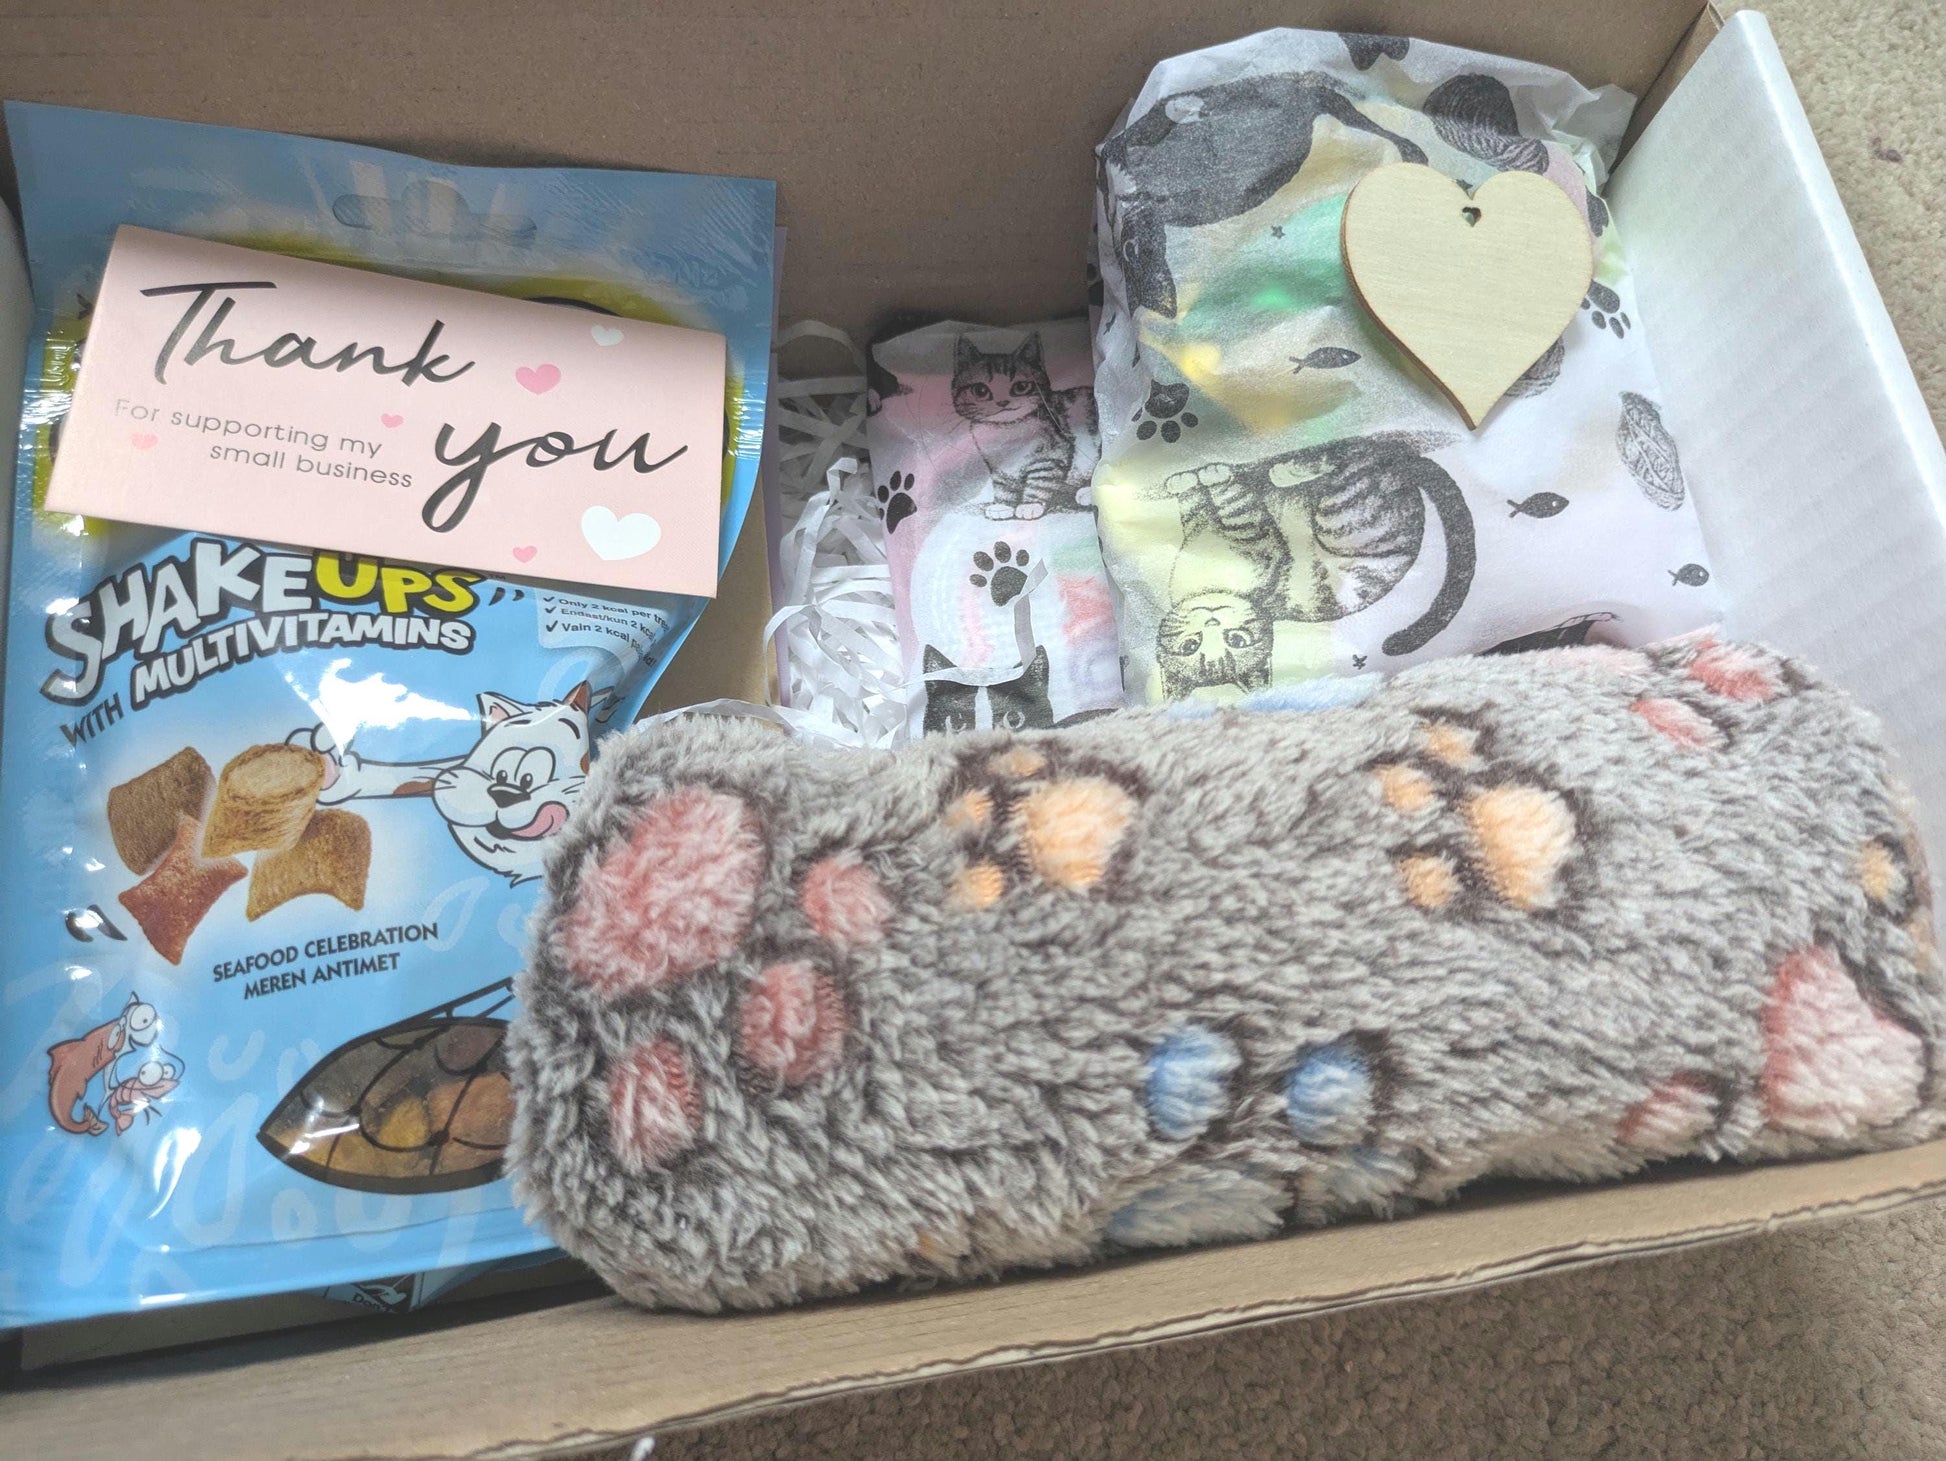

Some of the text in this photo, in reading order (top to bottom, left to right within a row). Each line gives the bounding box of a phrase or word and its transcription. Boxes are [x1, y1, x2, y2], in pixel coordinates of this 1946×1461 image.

[139, 281, 476, 387] Thank
[115, 398, 383, 459] For supporting my
[210, 444, 413, 489] small business
[421, 421, 689, 533] you
[558, 599, 588, 609] Only
[602, 604, 628, 614] kcal
[631, 609, 652, 619] per
[560, 608, 629, 625] Endast/kun
[630, 619, 639, 629] 2
[561, 622, 630, 642] Vain 2 kcal
[59, 611, 475, 748] WITH MULTIVITAMINS
[213, 923, 438, 982] SEAFOOD CELEBRATION
[244, 953, 401, 1000] MEREN ANTIMET
